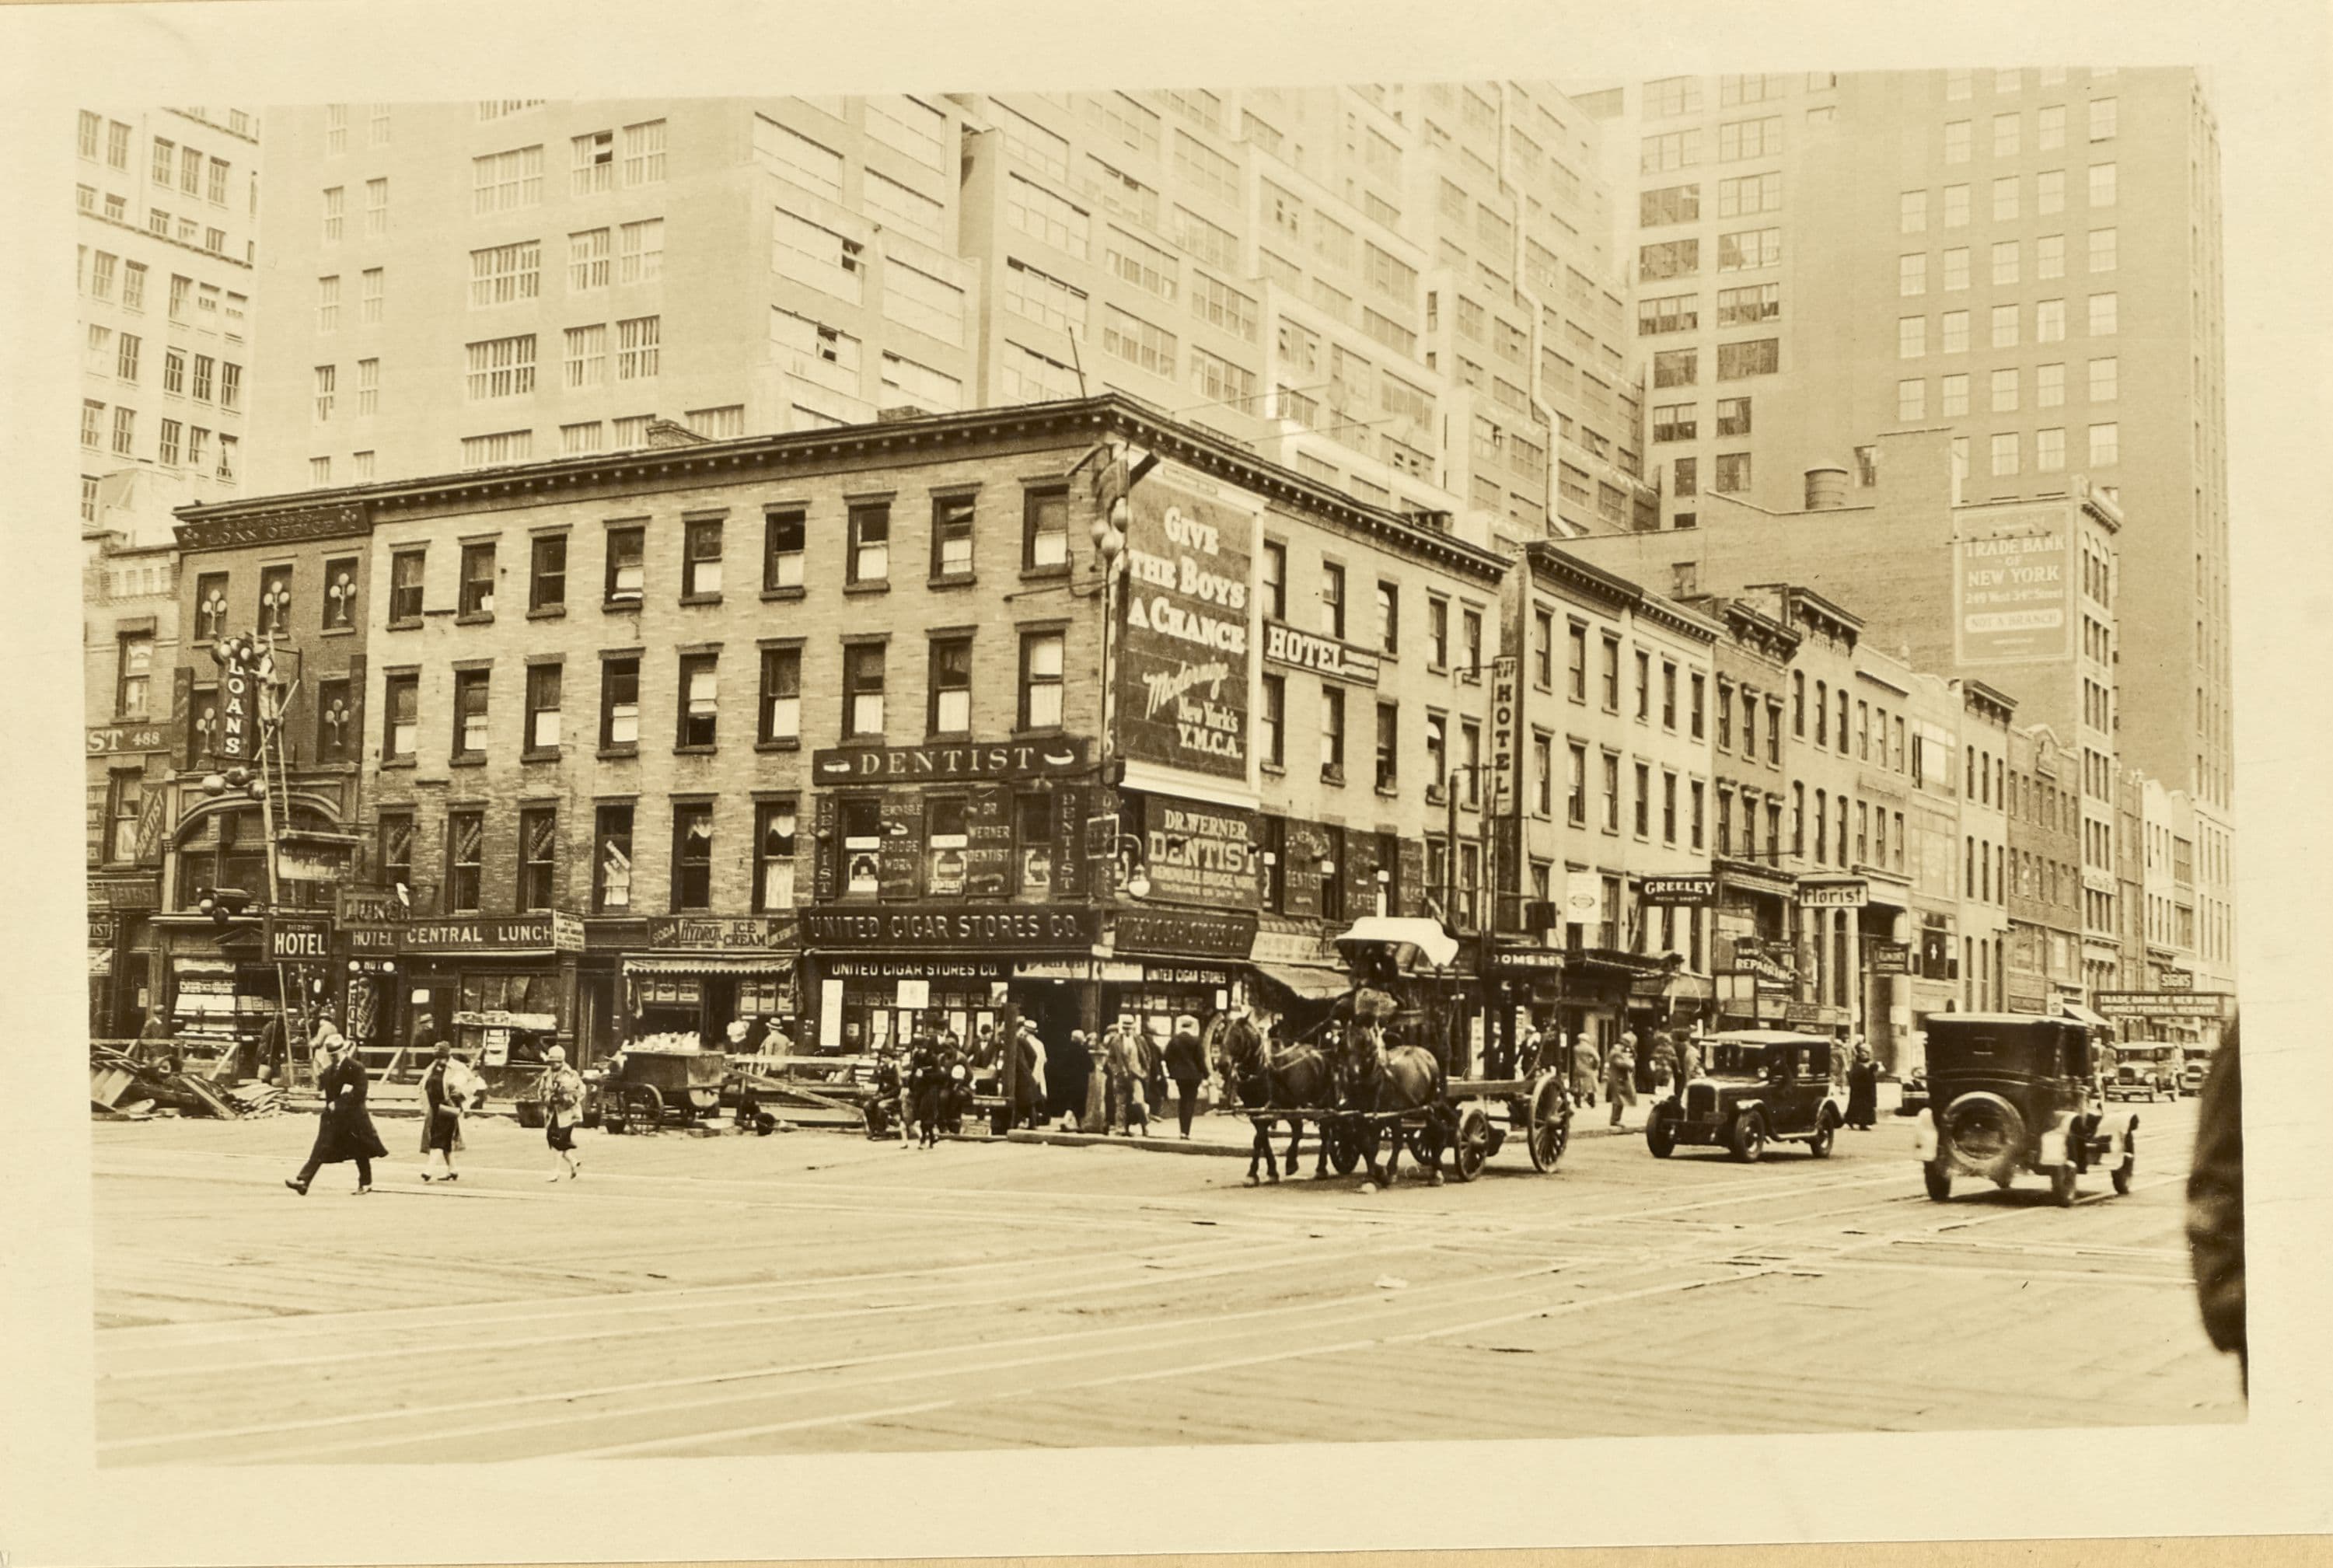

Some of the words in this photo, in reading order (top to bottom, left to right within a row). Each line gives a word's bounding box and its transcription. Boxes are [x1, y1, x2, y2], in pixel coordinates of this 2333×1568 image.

[1165, 506, 1219, 555] GIVE
[1964, 538, 2020, 557] TRADE
[2023, 534, 2066, 553] BANK
[1129, 550, 1176, 589] THE
[1180, 555, 1245, 609] BOYS
[1968, 569, 2004, 586] NEW
[2011, 565, 2059, 584] YORK
[1127, 597, 1149, 629] A
[1151, 597, 1245, 655] CHANCE
[1268, 625, 1346, 676] HOTEL
[225, 658, 244, 754] LOANS
[132, 732, 160, 746] 488
[1494, 683, 1512, 794] HOTEL
[859, 746, 1035, 775] DENTIST
[969, 826, 1010, 838] WERNER
[1061, 793, 1076, 889] DENTIST
[881, 840, 919, 853] BRIDGE
[967, 849, 1010, 862] DENTIST
[1149, 830, 1259, 875] DENTIST
[1644, 881, 1717, 895] GREELEY
[1803, 887, 1863, 903] Florist
[344, 899, 410, 920] LUNCH
[407, 927, 483, 944] CENTRAL
[498, 925, 554, 942] LUNCH
[653, 923, 676, 943] SODA
[733, 921, 756, 933] ICE
[809, 916, 880, 938] UNITED
[890, 915, 949, 938] CIGAR
[958, 914, 1040, 938] STORES
[274, 933, 327, 955] HOTEL
[353, 931, 395, 946] HOTEL
[723, 934, 767, 947] CREAM
[832, 963, 878, 976] UNITED
[883, 963, 923, 976] CIGAR
[927, 963, 976, 976] STORES
[1146, 969, 1173, 982] UNITED
[1175, 969, 1198, 983] CIGAR
[1200, 970, 1226, 983] STORES
[2161, 973, 2192, 987] SIGNS
